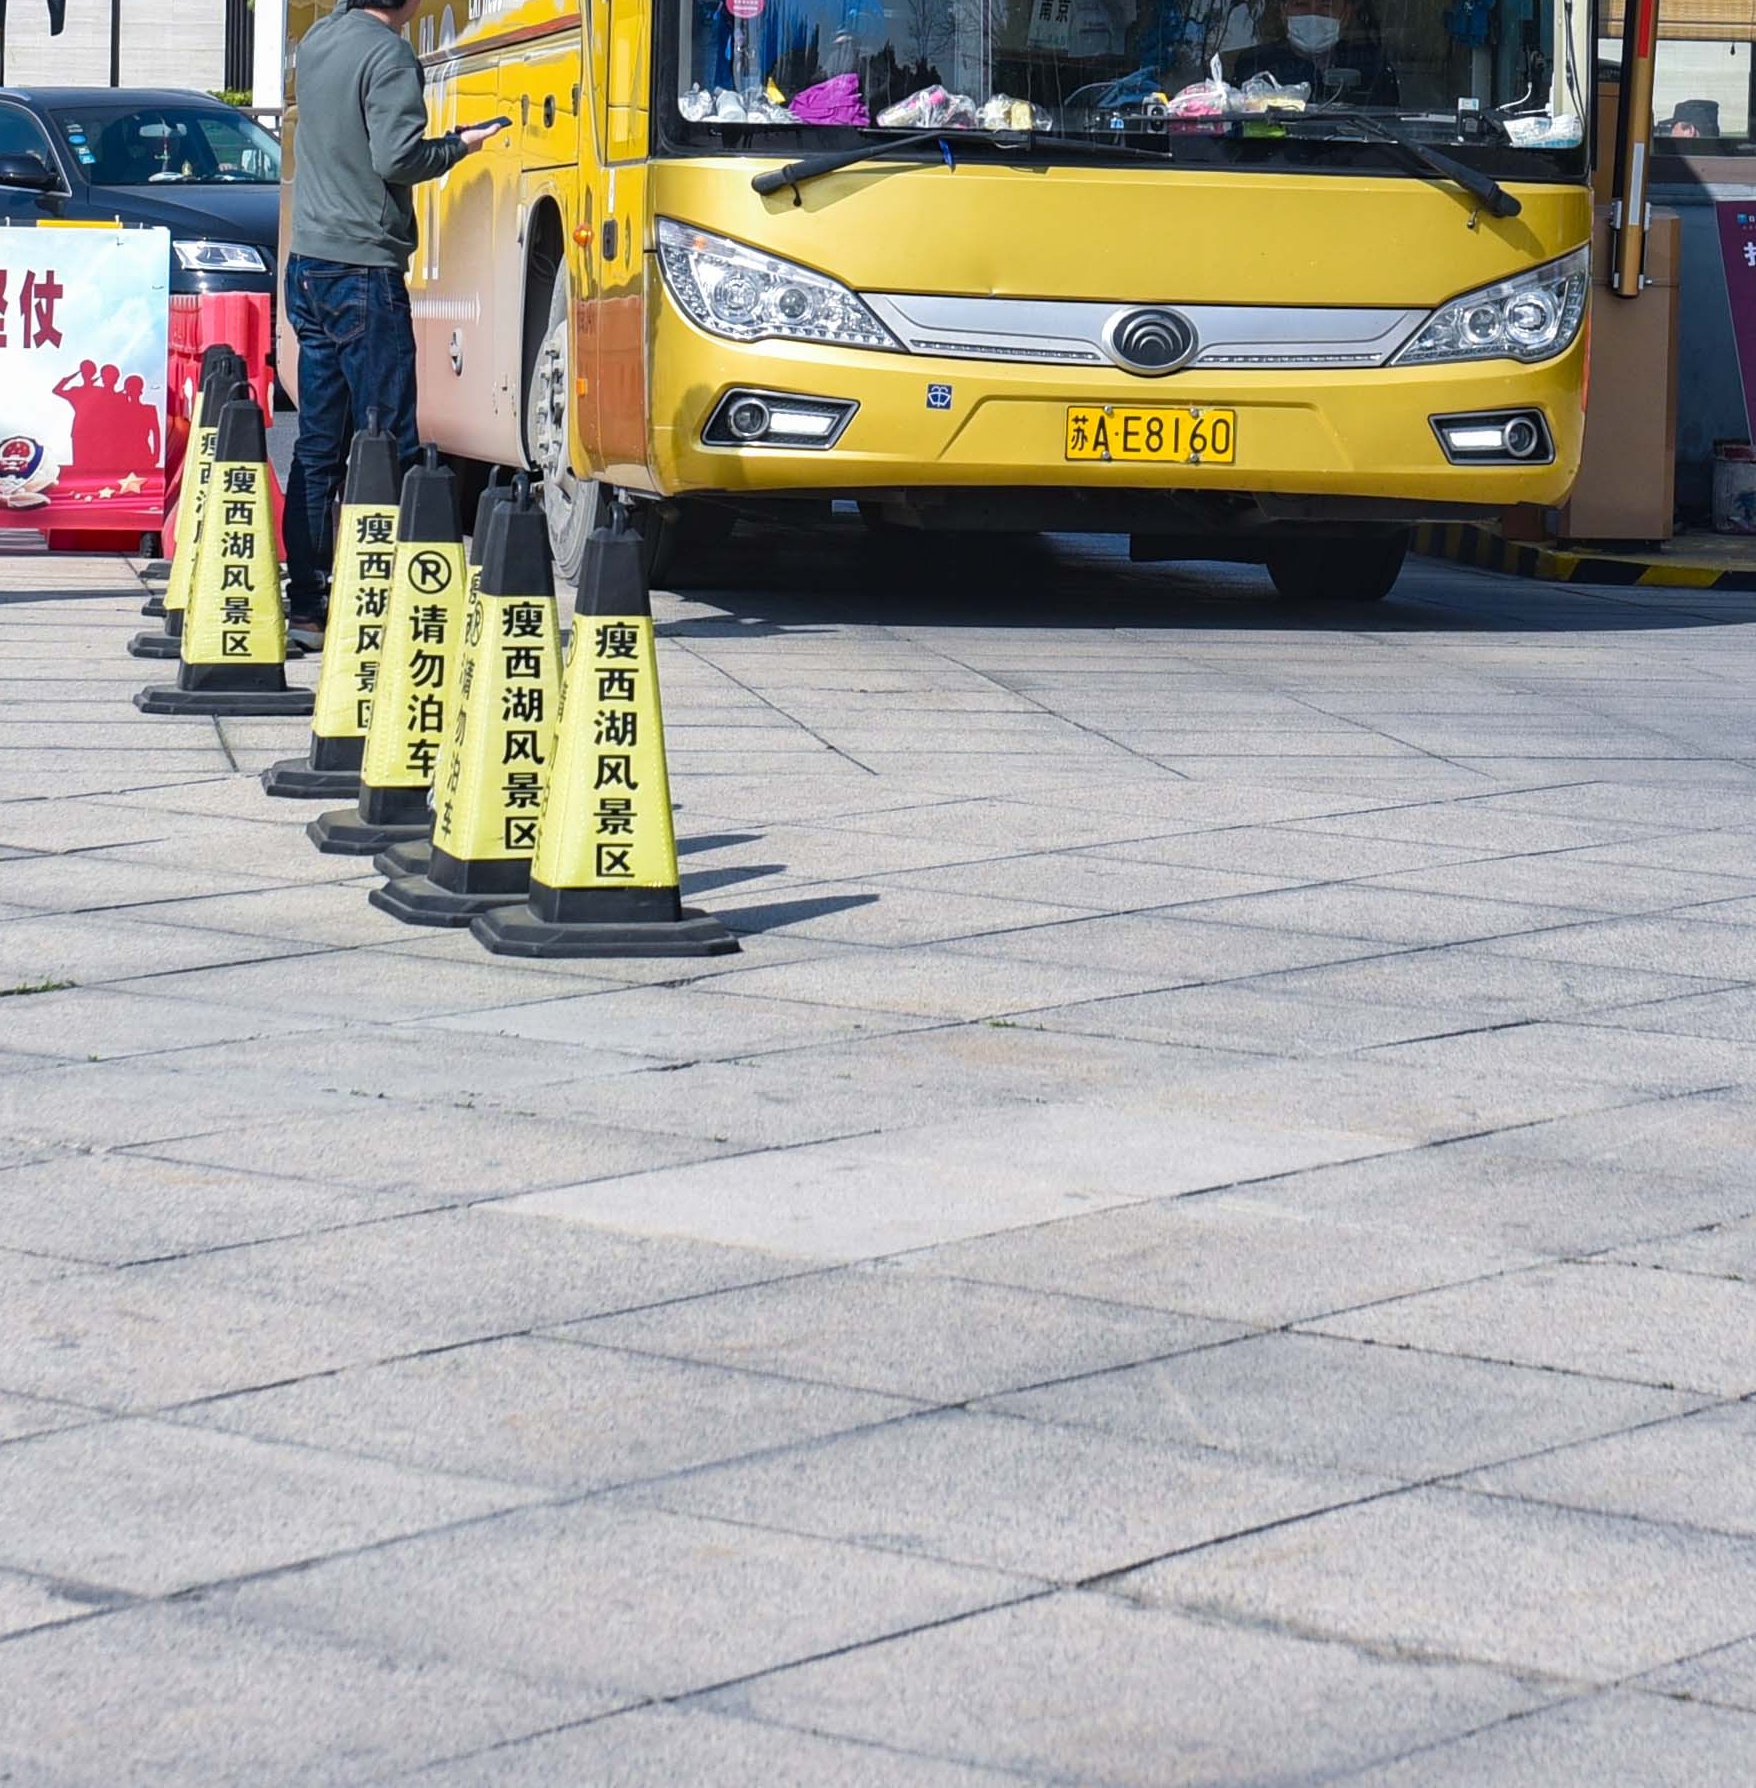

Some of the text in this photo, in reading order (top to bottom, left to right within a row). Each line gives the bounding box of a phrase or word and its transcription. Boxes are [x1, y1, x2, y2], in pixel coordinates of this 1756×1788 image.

[220, 465, 258, 657] 瘦西湖风景区
[406, 605, 448, 778] 请勿泊车
[501, 592, 545, 849] 瘦西湖风景区
[594, 622, 641, 878] 瘦西湖风景区
